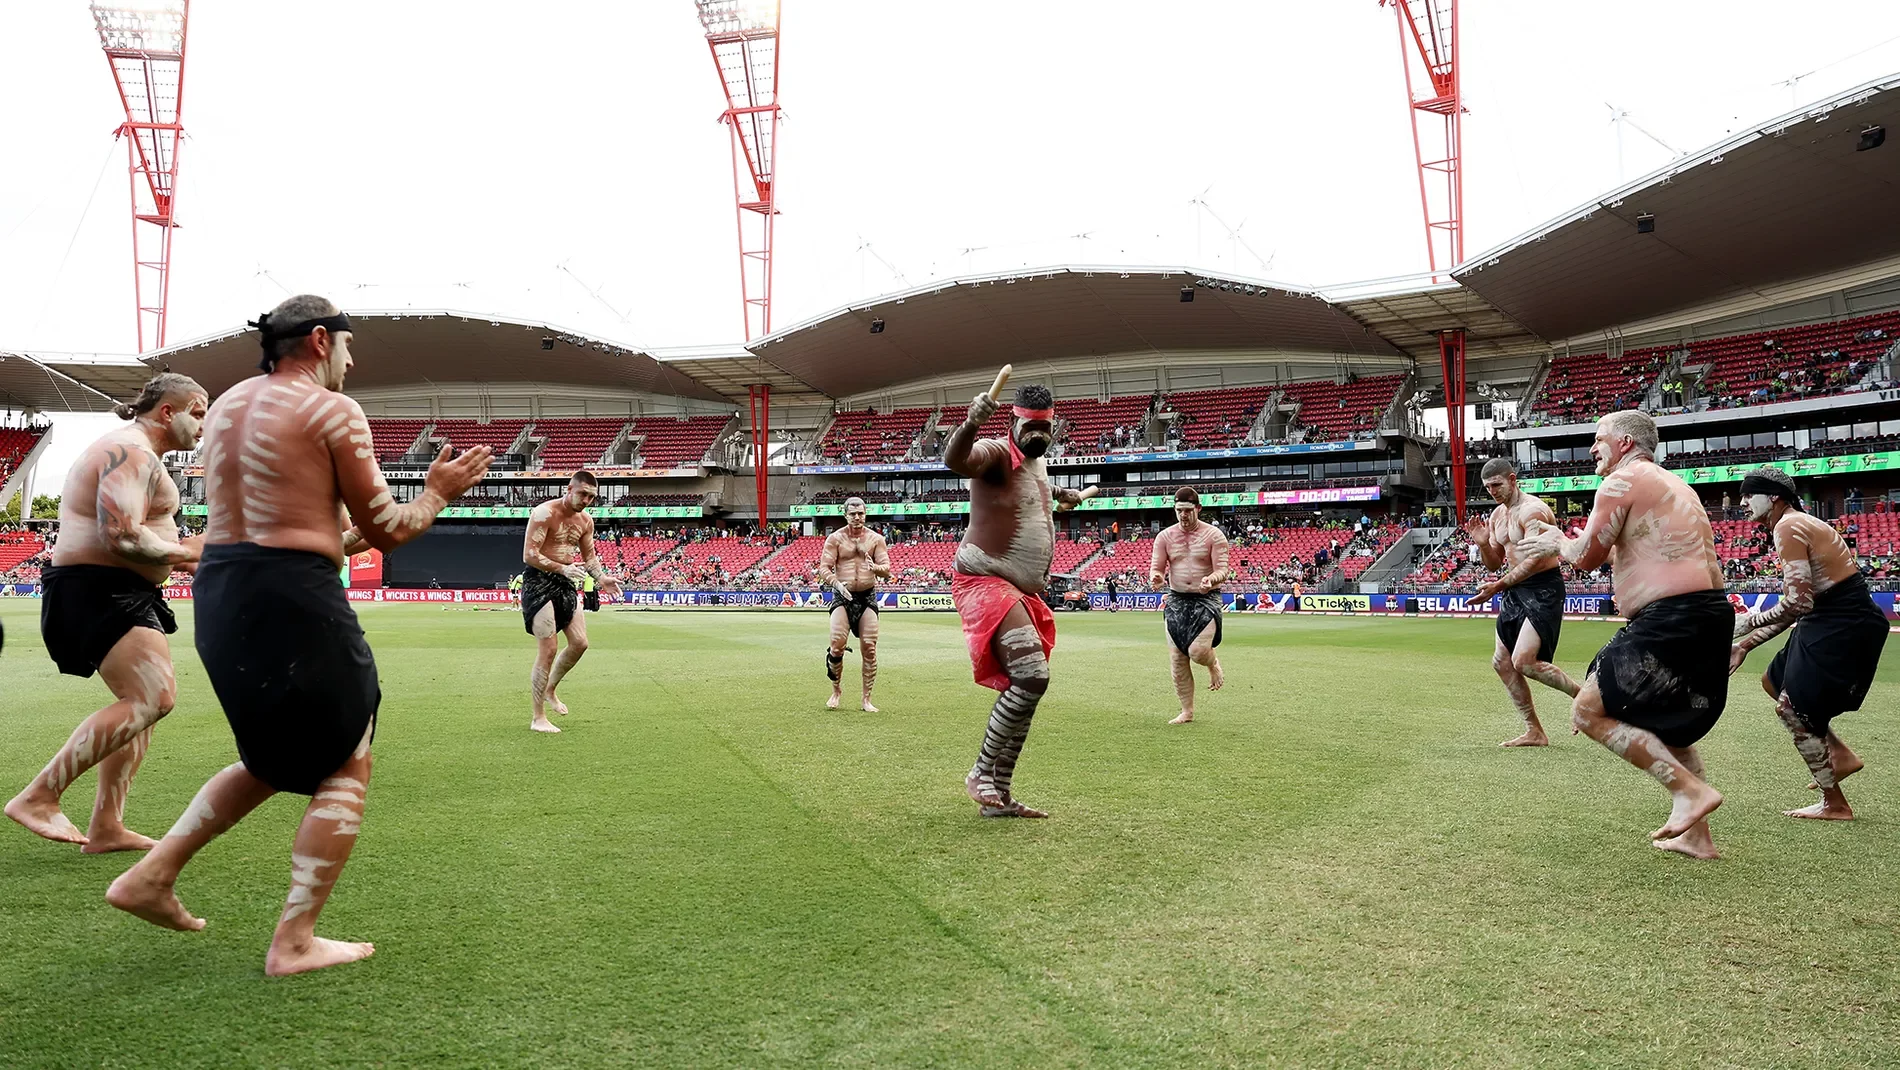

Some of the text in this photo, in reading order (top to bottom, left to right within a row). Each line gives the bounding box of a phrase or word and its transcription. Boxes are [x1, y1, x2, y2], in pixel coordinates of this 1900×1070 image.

[1299, 490, 1340, 502] 00:00
[348, 591, 372, 600] WINGS
[386, 592, 452, 600] WICKETS & WINGS
[465, 592, 498, 600] WICKETS
[500, 592, 506, 600] &
[632, 593, 778, 605] FEEL ALIVE THS SUMMER
[912, 597, 952, 605] Tickets
[1094, 596, 1156, 608] SUMMER
[1318, 598, 1366, 608] Tickts
[1418, 598, 1444, 610] EEL
